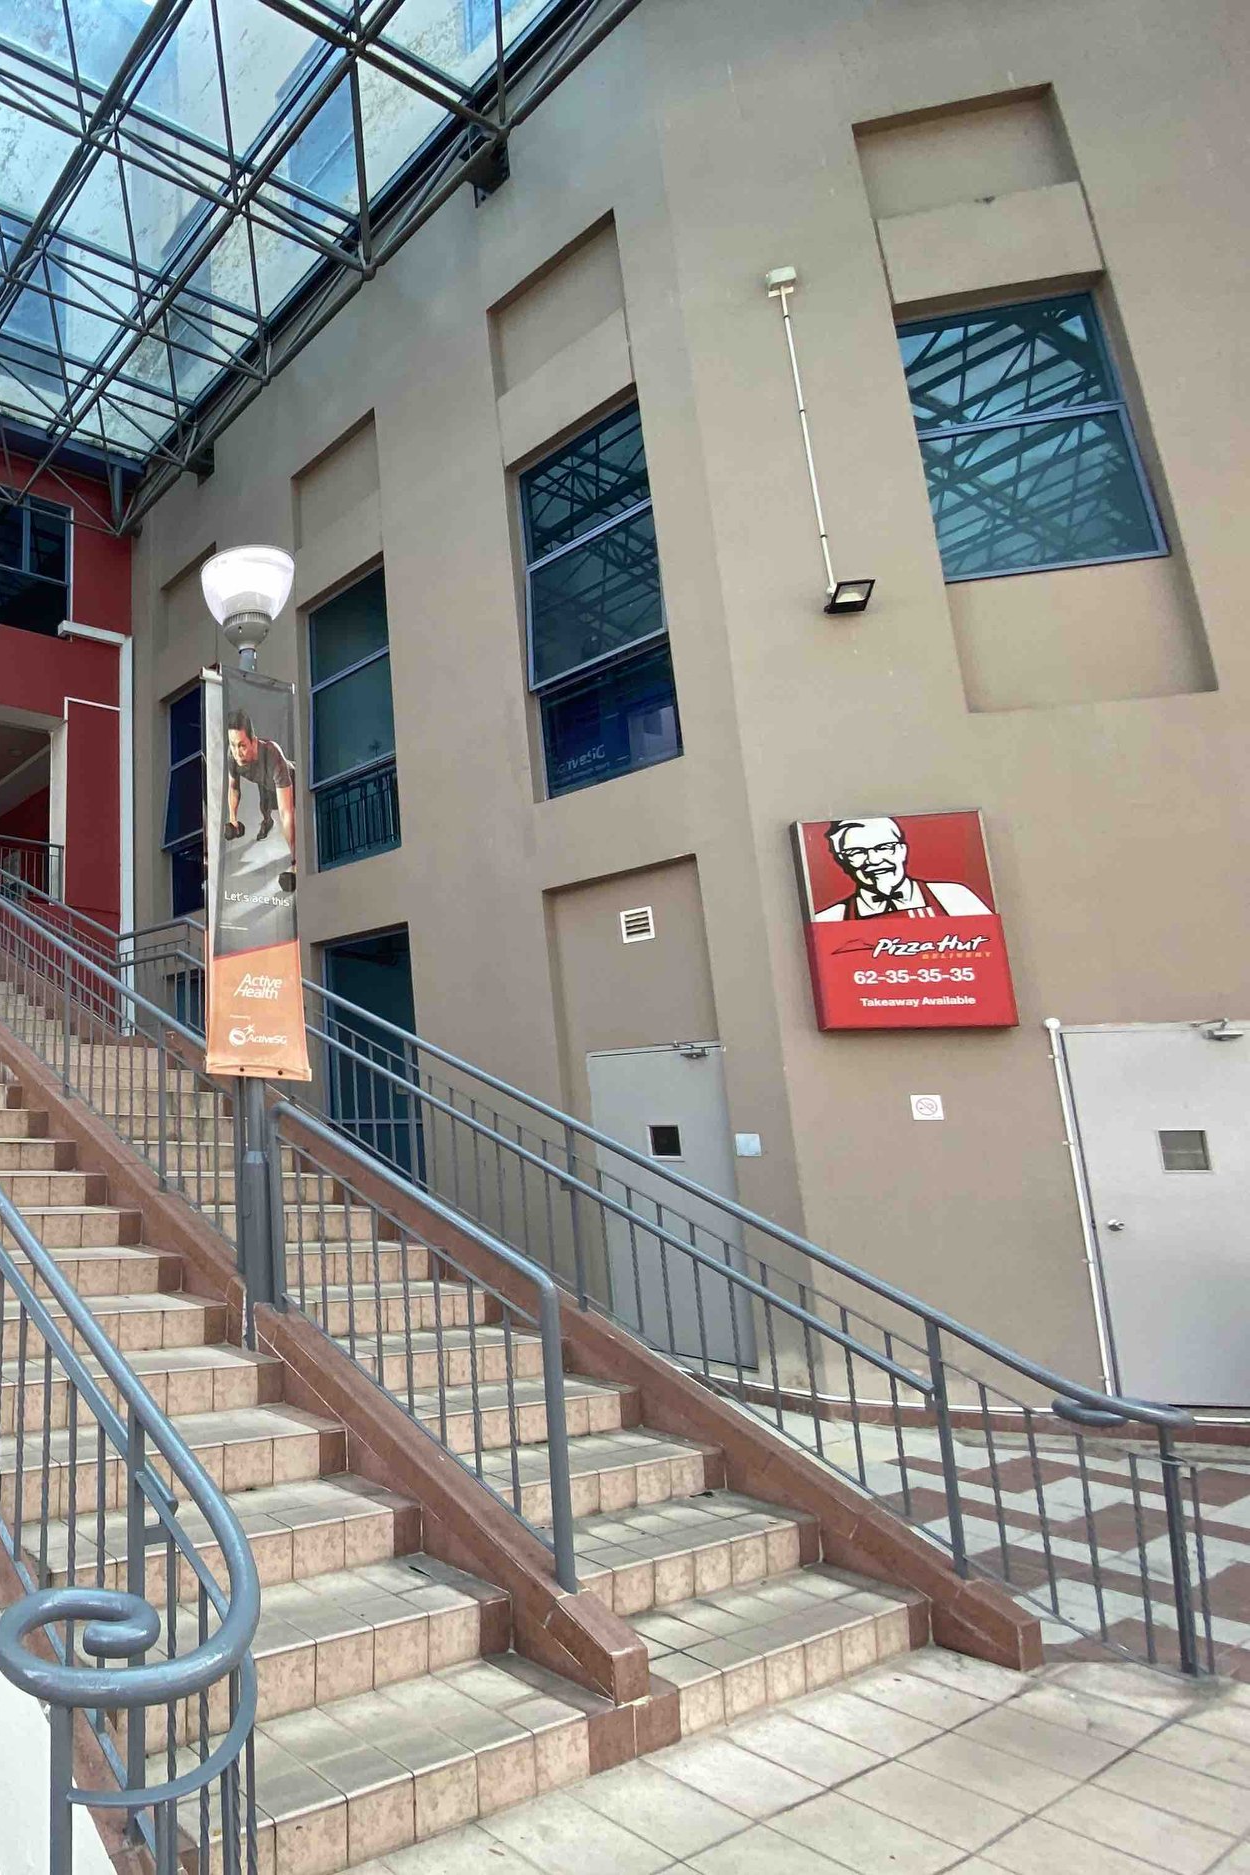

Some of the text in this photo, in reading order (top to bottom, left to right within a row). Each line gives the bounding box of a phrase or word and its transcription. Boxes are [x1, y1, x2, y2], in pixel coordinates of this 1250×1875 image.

[224, 890, 290, 907] Let's ace this
[872, 934, 990, 959] Pizza Hut
[921, 951, 992, 960] DELIVERY
[236, 973, 283, 990] Active
[853, 967, 976, 985] 62-35-35-35
[234, 985, 278, 1000] Health
[860, 995, 977, 1008] Takeaway Available
